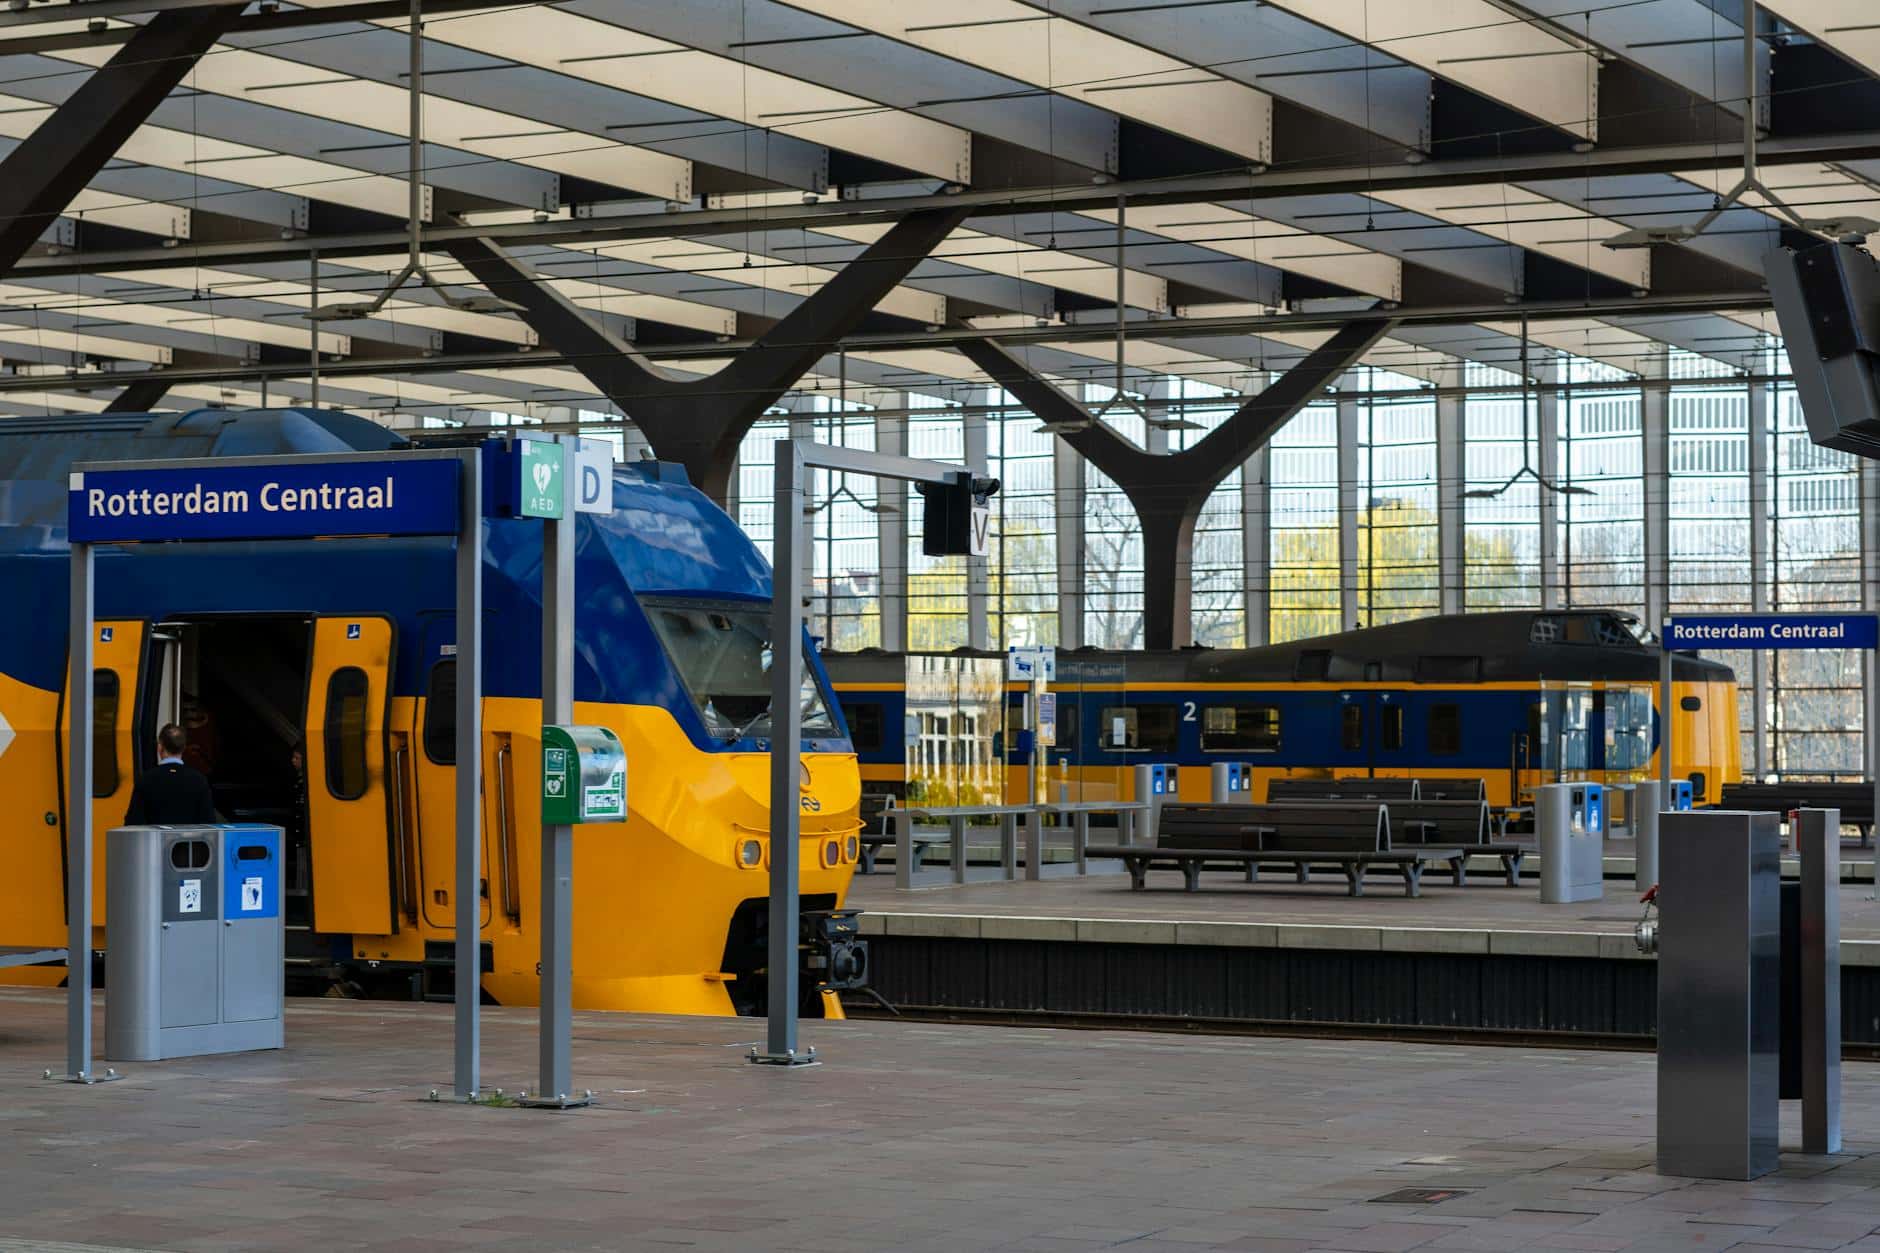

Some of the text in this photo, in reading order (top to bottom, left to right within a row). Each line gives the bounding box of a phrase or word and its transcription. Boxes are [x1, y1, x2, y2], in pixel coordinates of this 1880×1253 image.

[88, 477, 394, 517] Rotterdam Centraal
[582, 465, 600, 504] D
[531, 497, 554, 511] AED
[973, 511, 988, 552] V
[1673, 622, 1844, 639] Rotterdam Centraal
[1183, 701, 1197, 722] 2
